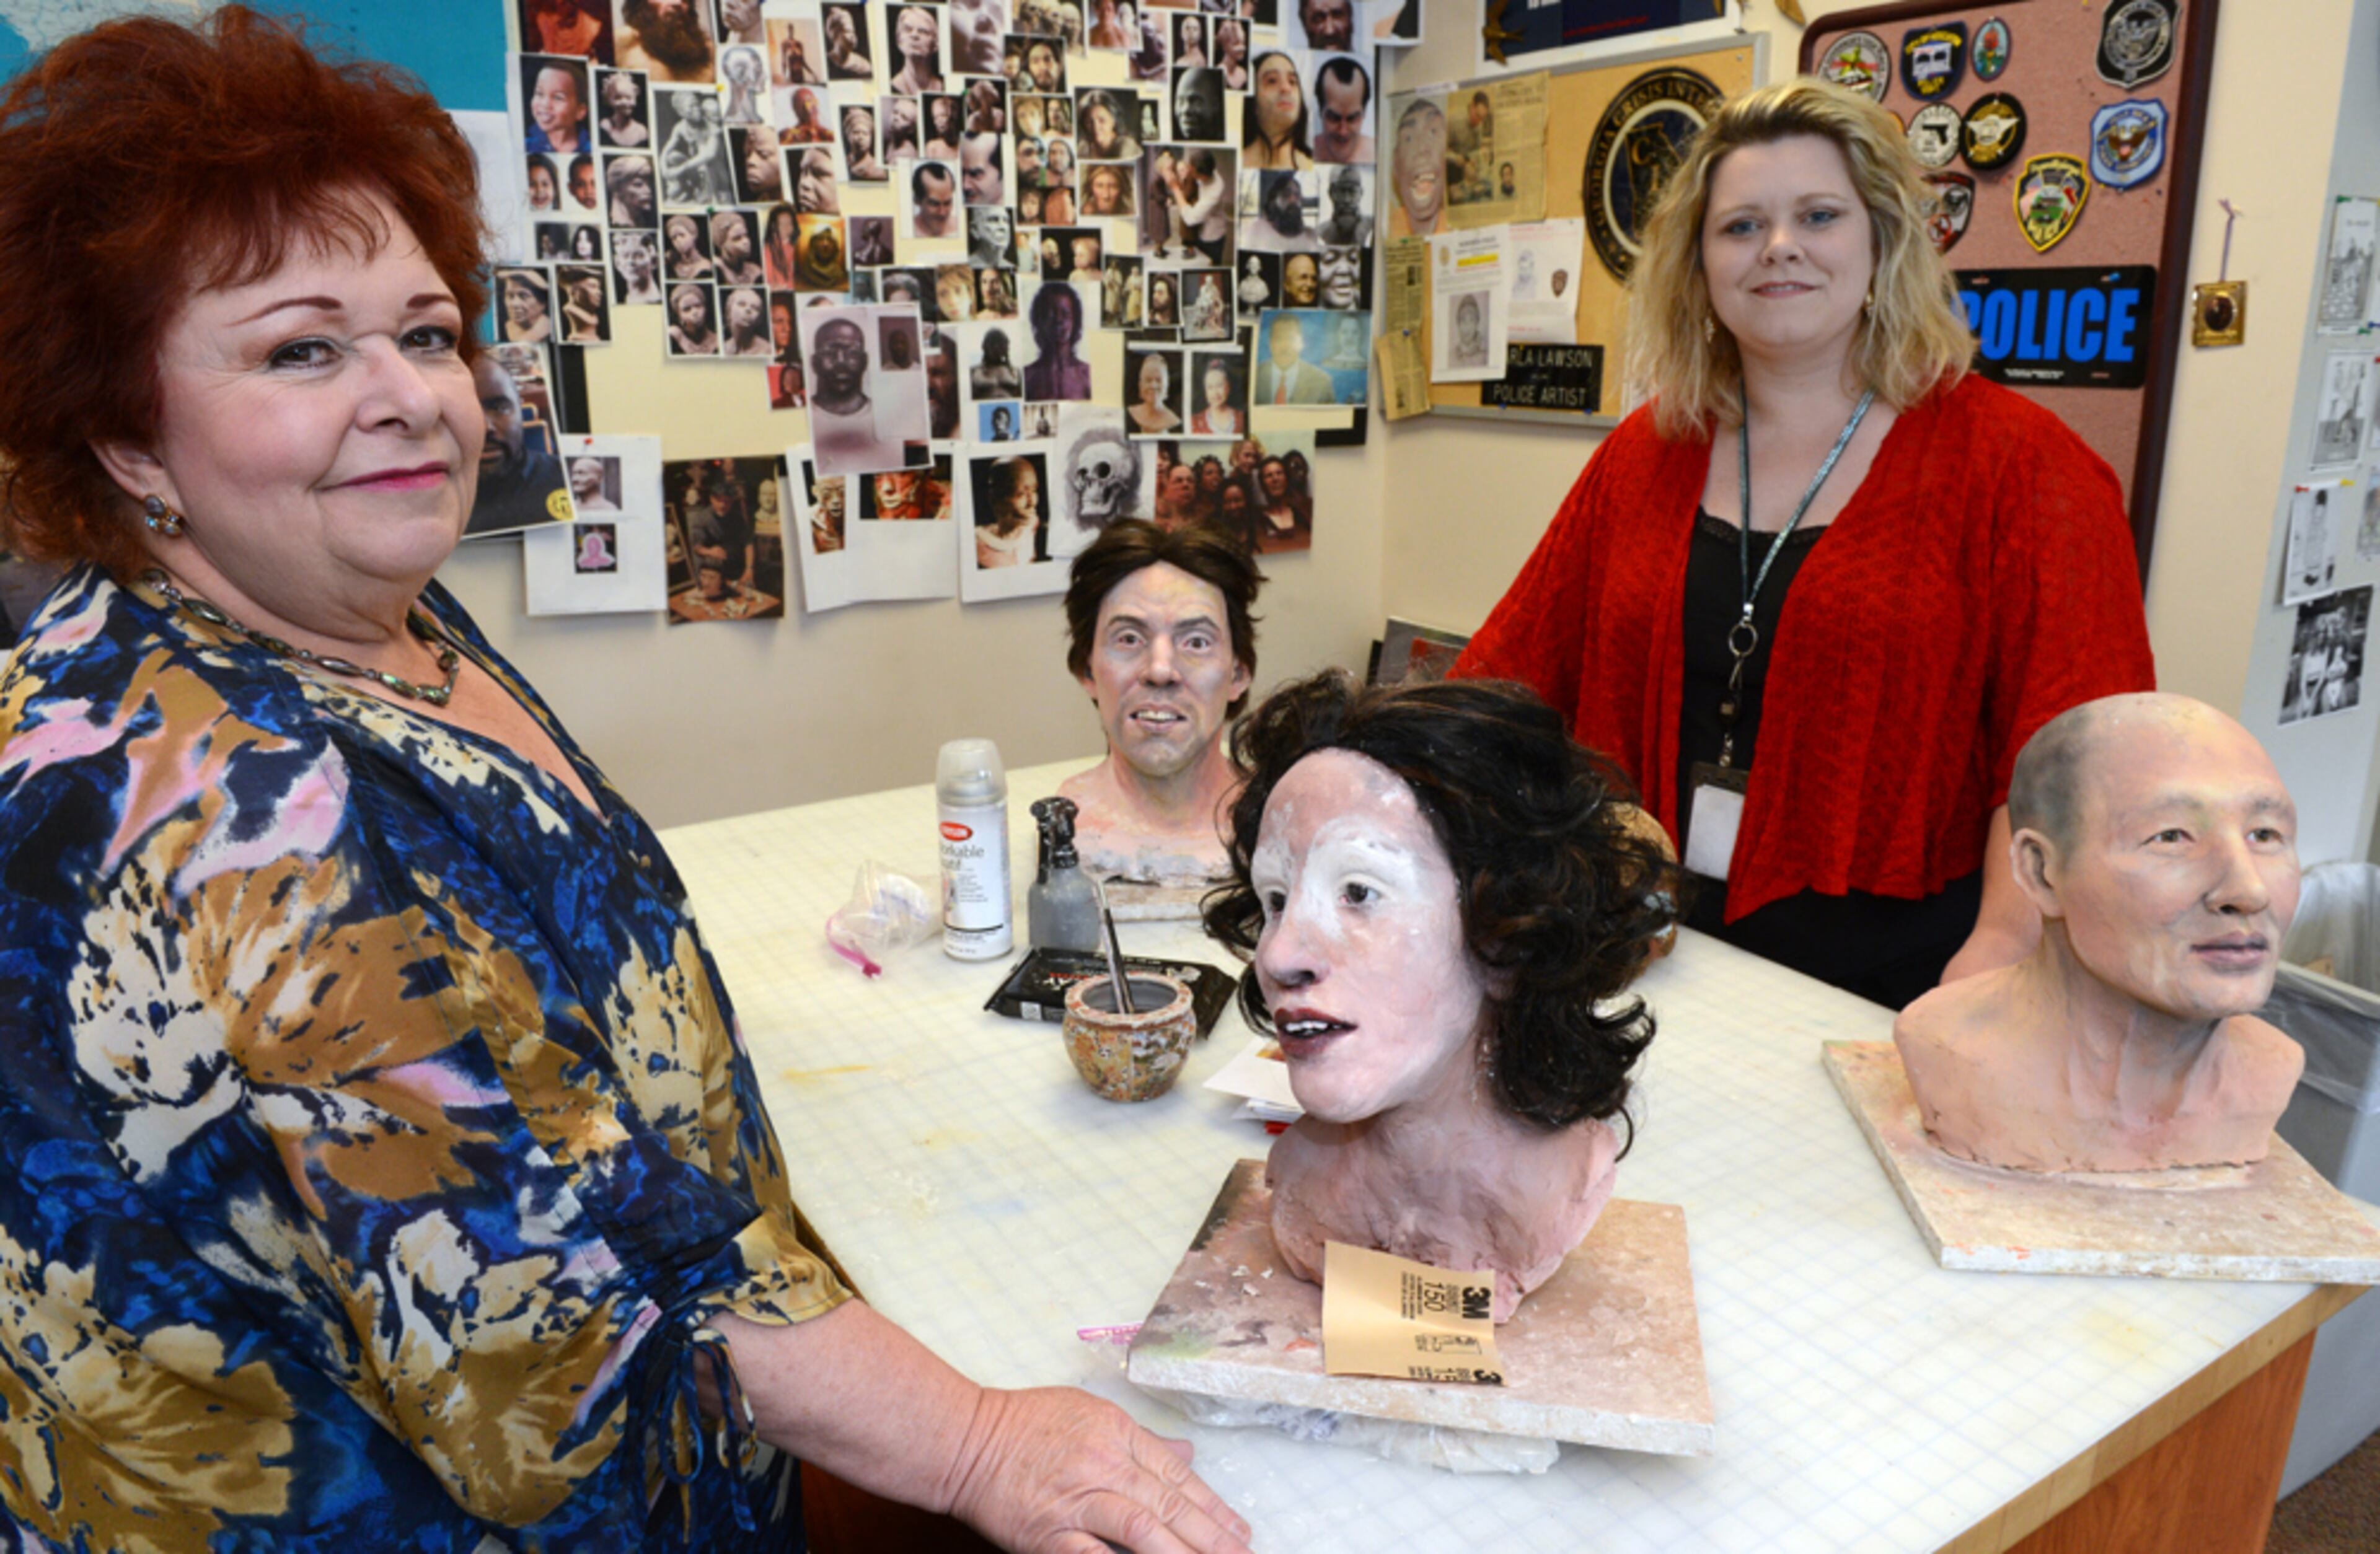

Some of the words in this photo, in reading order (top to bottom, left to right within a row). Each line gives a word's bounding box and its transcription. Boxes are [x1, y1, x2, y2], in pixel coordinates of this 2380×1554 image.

[1592, 129, 1616, 227] GEORGIA
[1612, 81, 1664, 127] CRISIS
[1508, 346, 1534, 367] RLA
[1537, 348, 1593, 369] LAWSON
[1492, 382, 1536, 403] POLICE
[1539, 385, 1587, 406] ARTIST
[941, 844, 984, 859] orkable
[1424, 1281, 1445, 1312] 150
[1462, 1286, 1491, 1320] 3M
